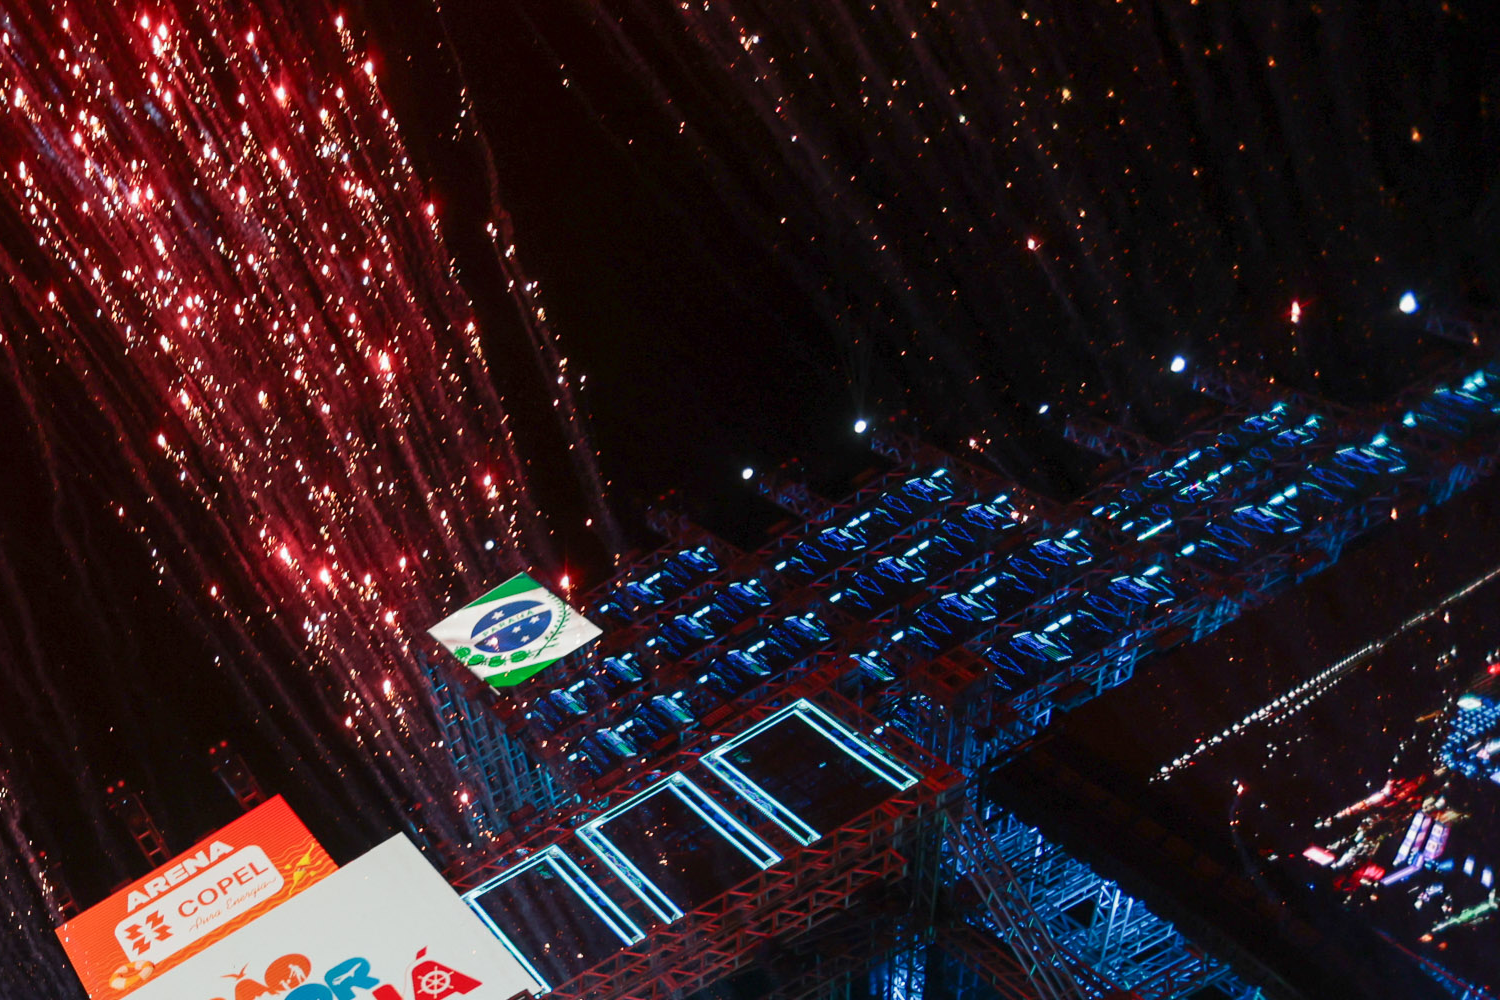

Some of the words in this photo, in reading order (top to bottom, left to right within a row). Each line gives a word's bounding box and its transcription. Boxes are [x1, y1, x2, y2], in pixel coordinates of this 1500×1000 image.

[127, 840, 234, 913] ARENA
[178, 862, 269, 917] COPEL
[189, 909, 222, 932] Pura
[226, 877, 276, 910] Energia
